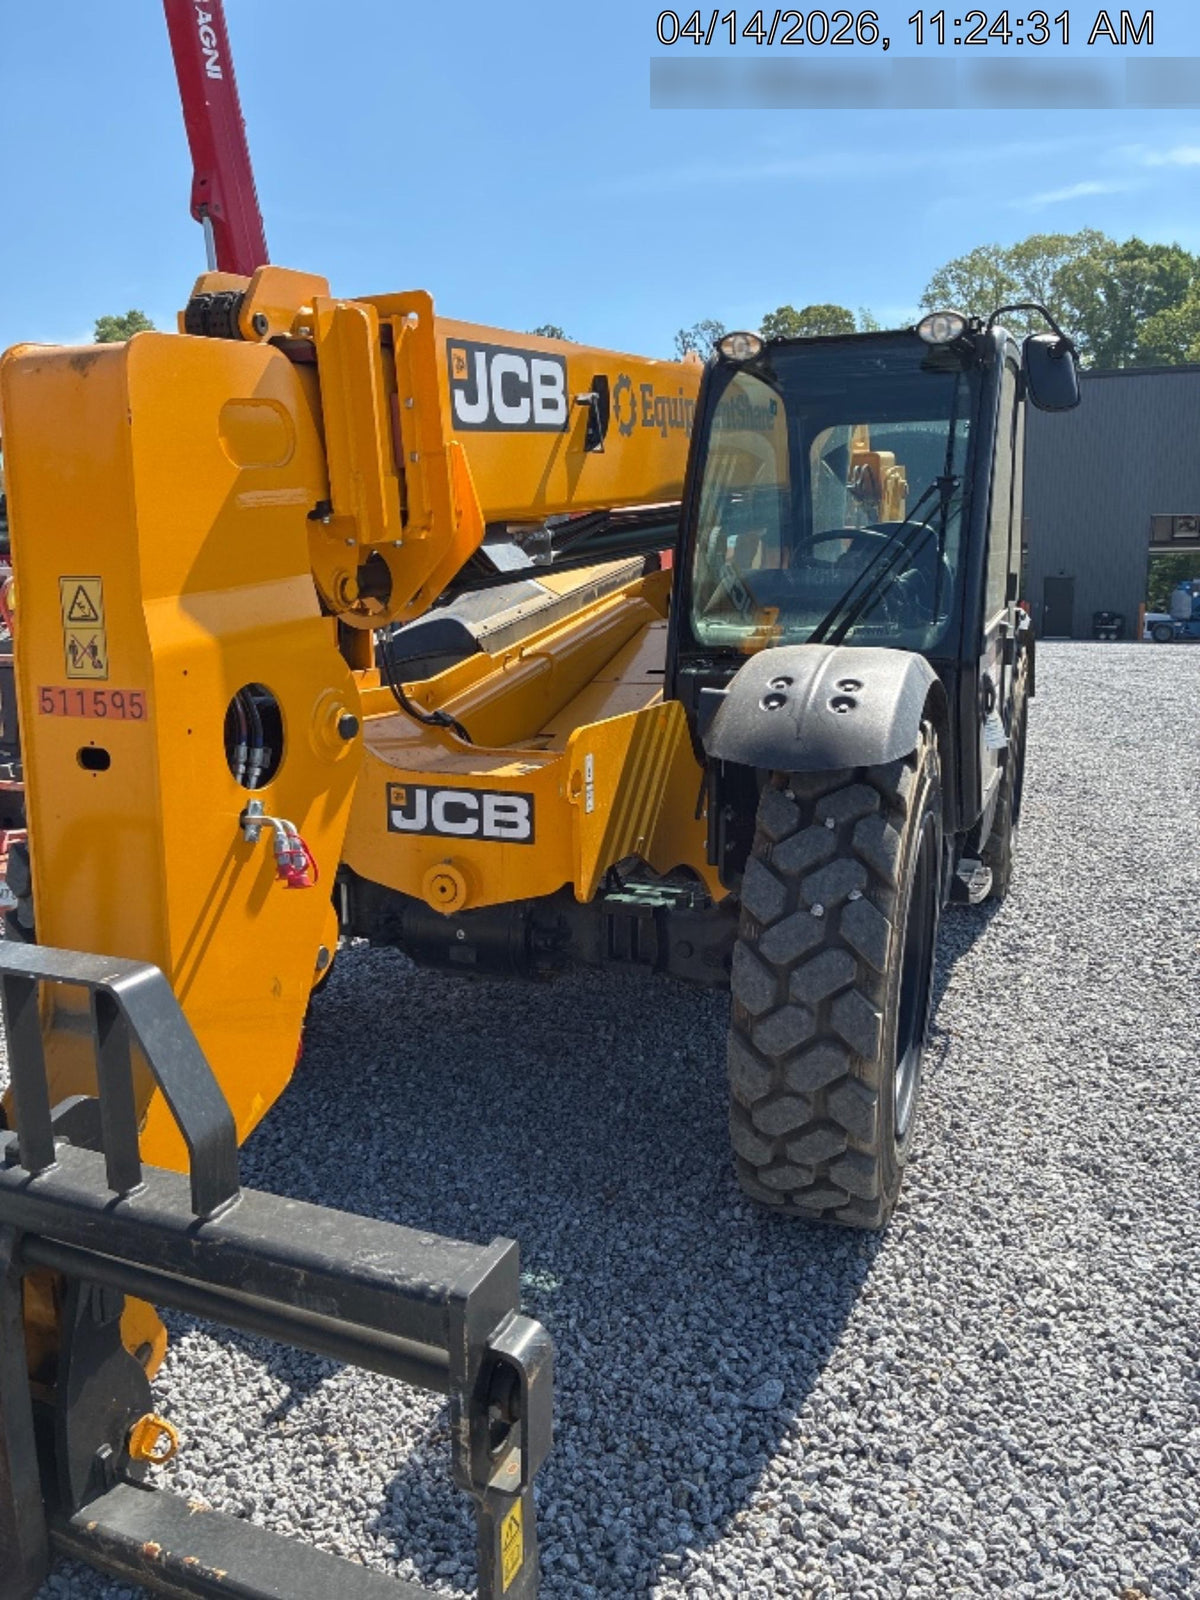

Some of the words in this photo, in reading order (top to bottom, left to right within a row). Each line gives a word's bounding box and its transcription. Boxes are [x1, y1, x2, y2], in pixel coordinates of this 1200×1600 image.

[194, 0, 222, 79] AGNI
[453, 350, 568, 425] JCB
[41, 688, 144, 719] 511595
[391, 788, 531, 840] JCB
